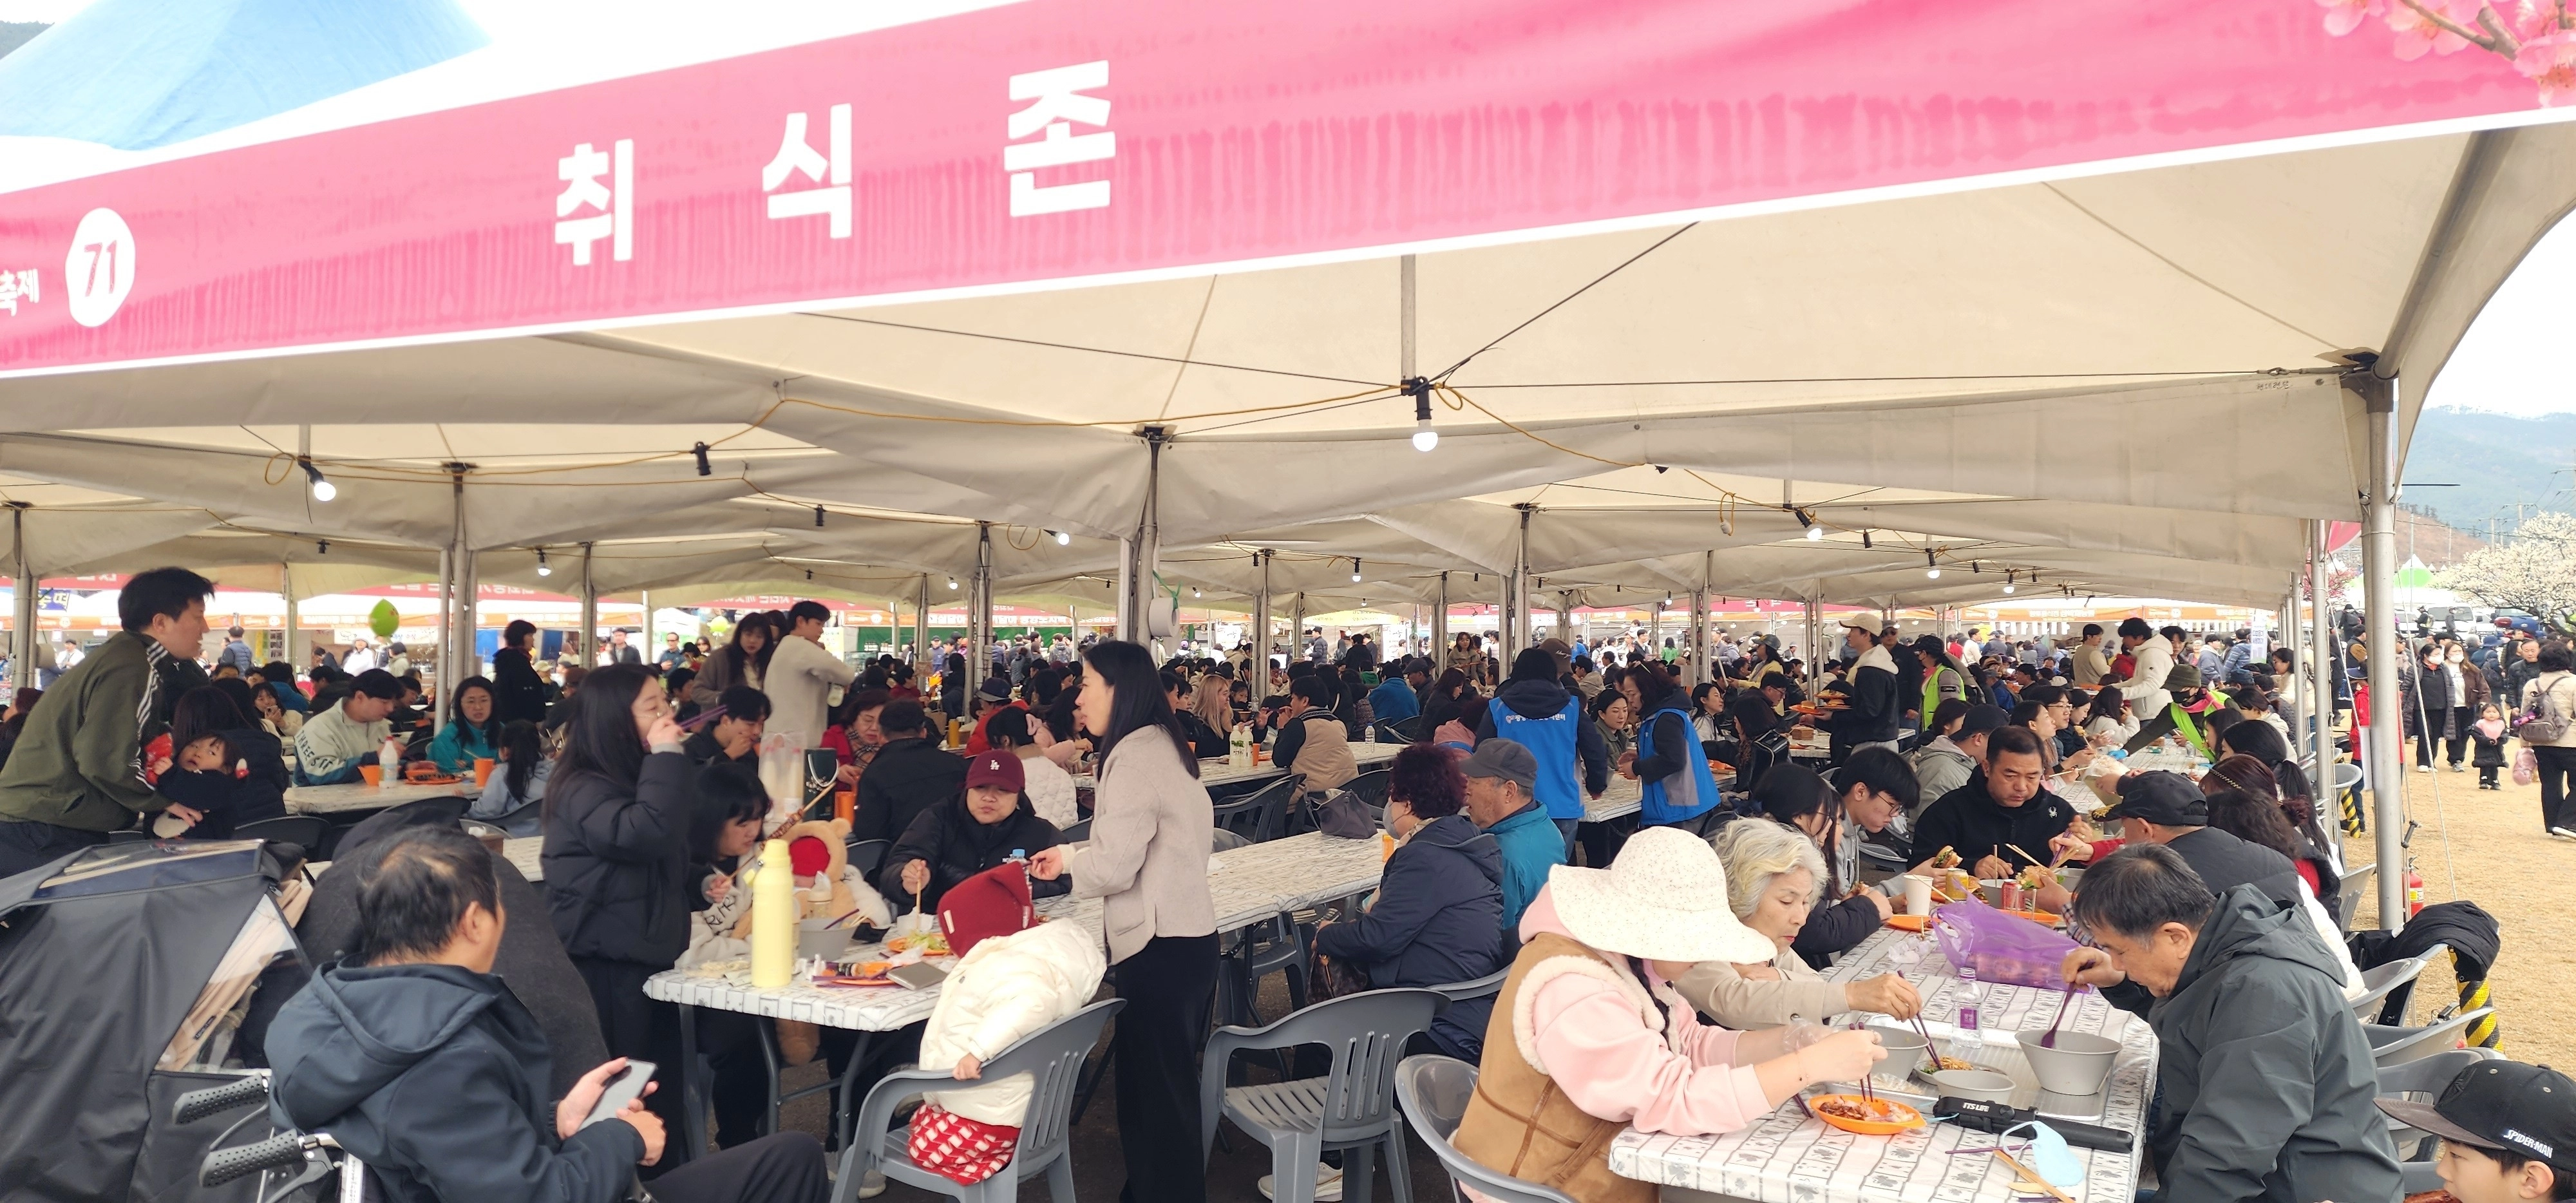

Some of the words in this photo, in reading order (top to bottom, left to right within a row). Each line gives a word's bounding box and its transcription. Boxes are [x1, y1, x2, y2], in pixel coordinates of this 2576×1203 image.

[554, 138, 634, 266] 취
[762, 103, 852, 239] 식
[1004, 59, 1116, 218] 존
[84, 240, 117, 297] 71
[2502, 1129, 2553, 1159] SPIDER-MAN
